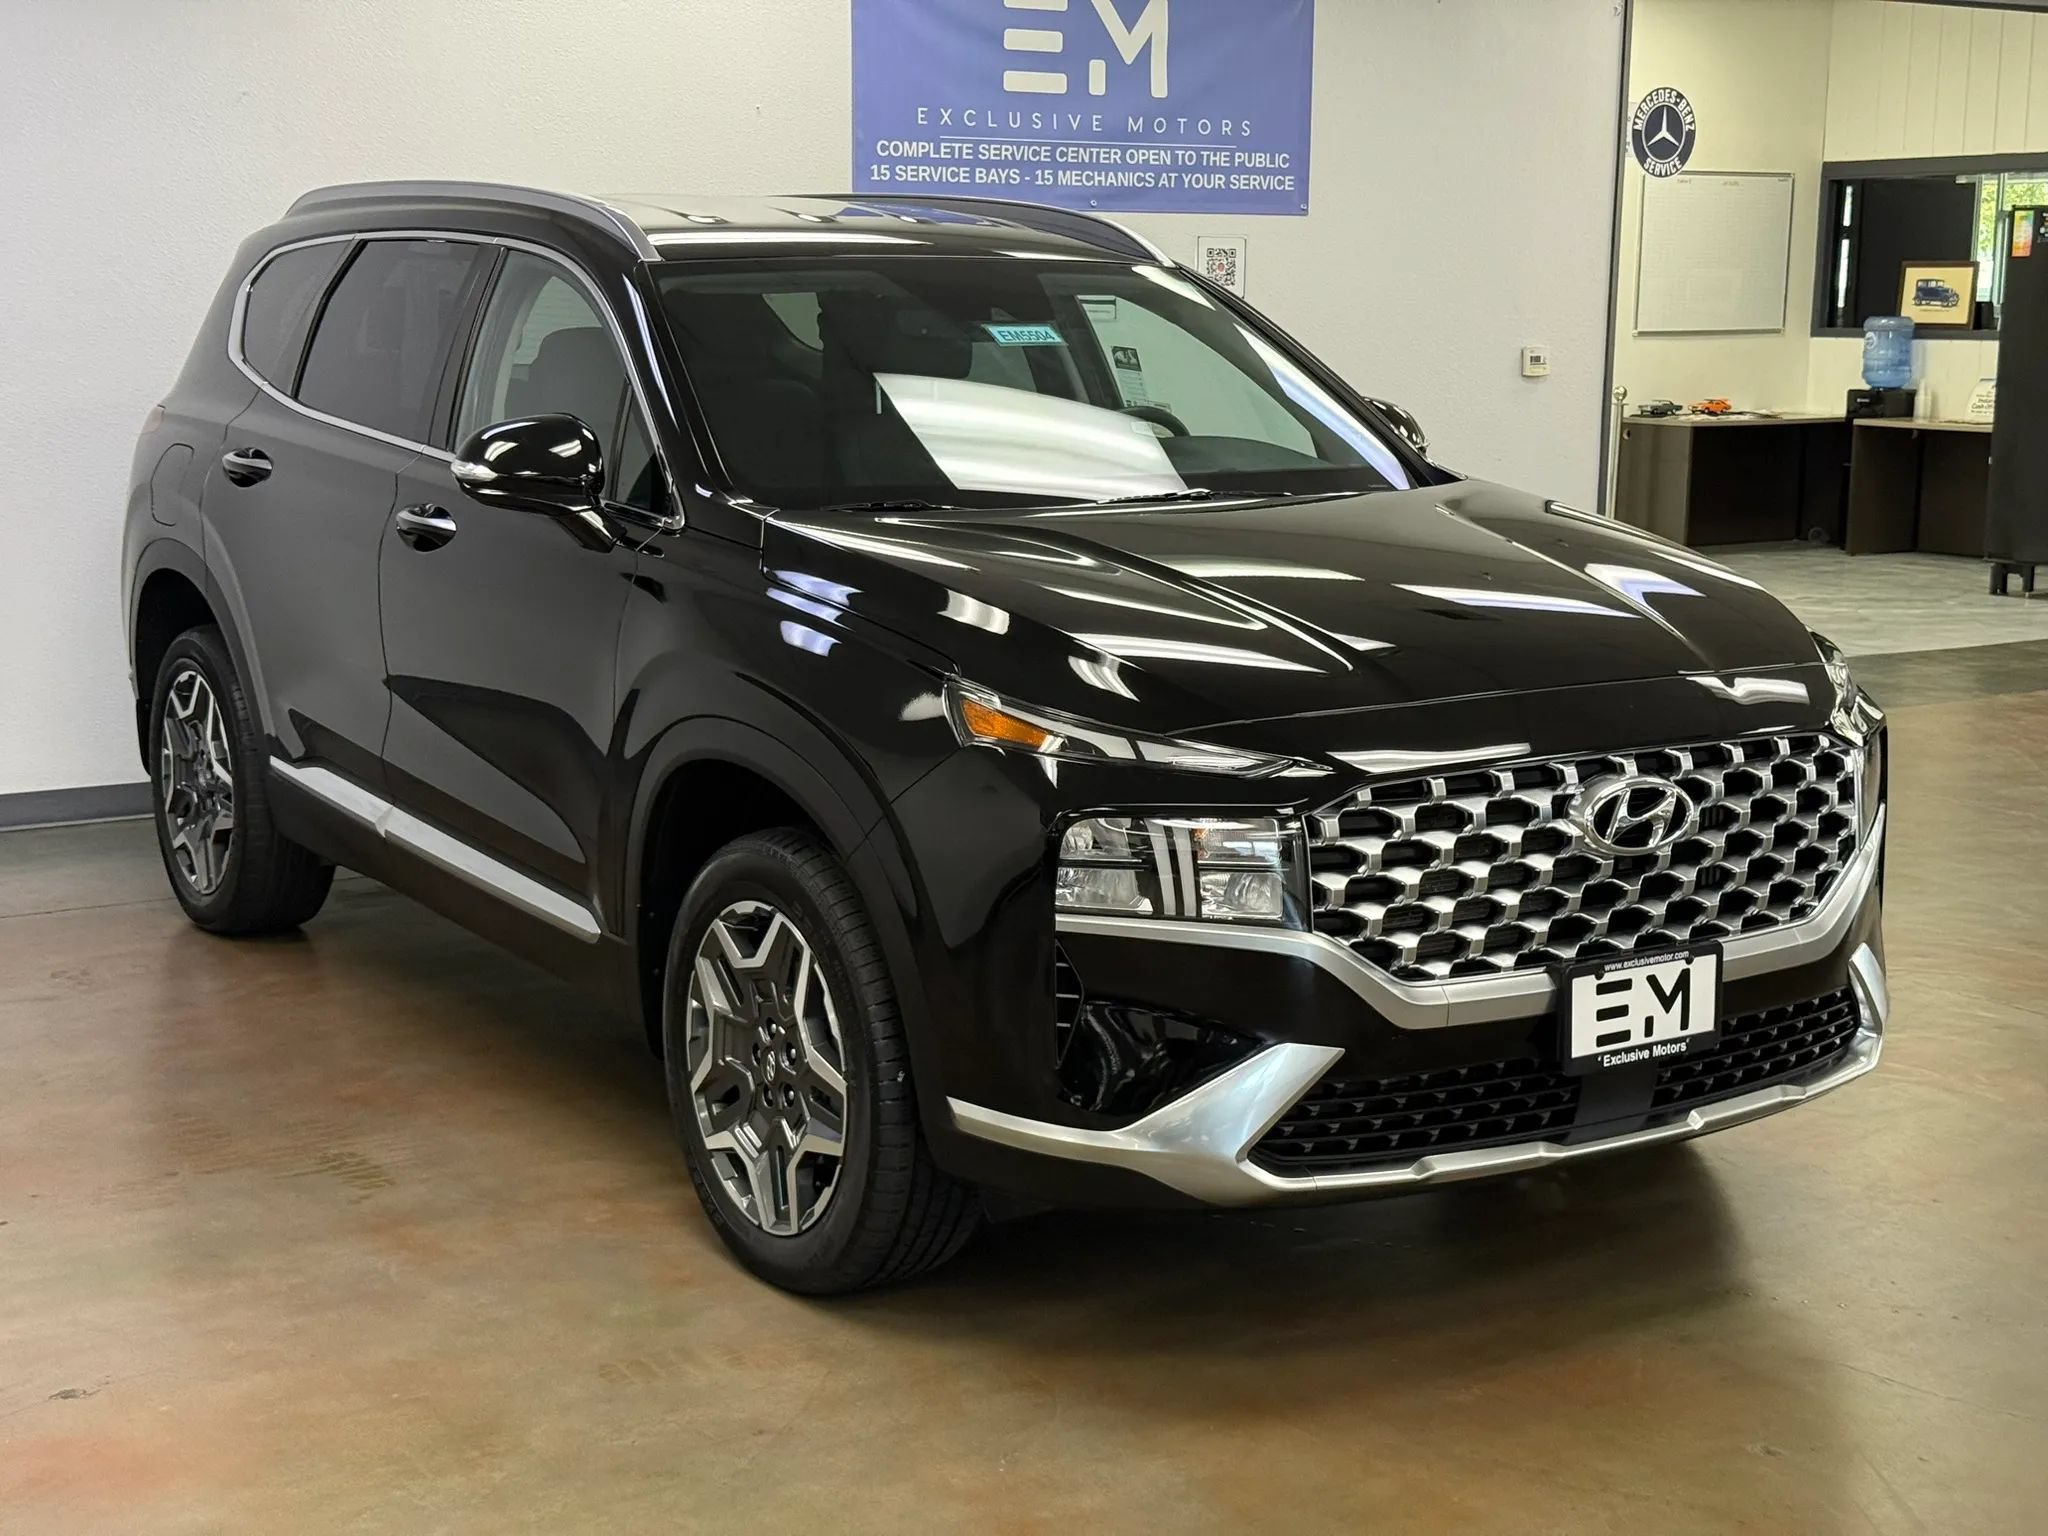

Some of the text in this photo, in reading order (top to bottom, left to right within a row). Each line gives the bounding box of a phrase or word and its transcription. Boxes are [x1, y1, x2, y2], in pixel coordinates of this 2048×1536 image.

[917, 107, 1251, 137] EXCLUSIVE MOTORS
[876, 140, 1290, 168] COMPLETE SERVICE CENTER OPEN TO THE PUBLIC
[1643, 156, 1683, 177] SERVICE
[870, 165, 891, 181] 15
[894, 165, 971, 183] SERVICE
[975, 168, 1021, 184] BAYS
[1034, 169, 1054, 185] 15
[1057, 170, 1155, 188] MECHANICS
[1158, 173, 1179, 188] AT
[1181, 173, 1226, 189] YOUR
[1229, 174, 1295, 191] SERVICE
[1603, 950, 1690, 972] www.exclusivemotor.com
[1595, 967, 1691, 1048] EM
